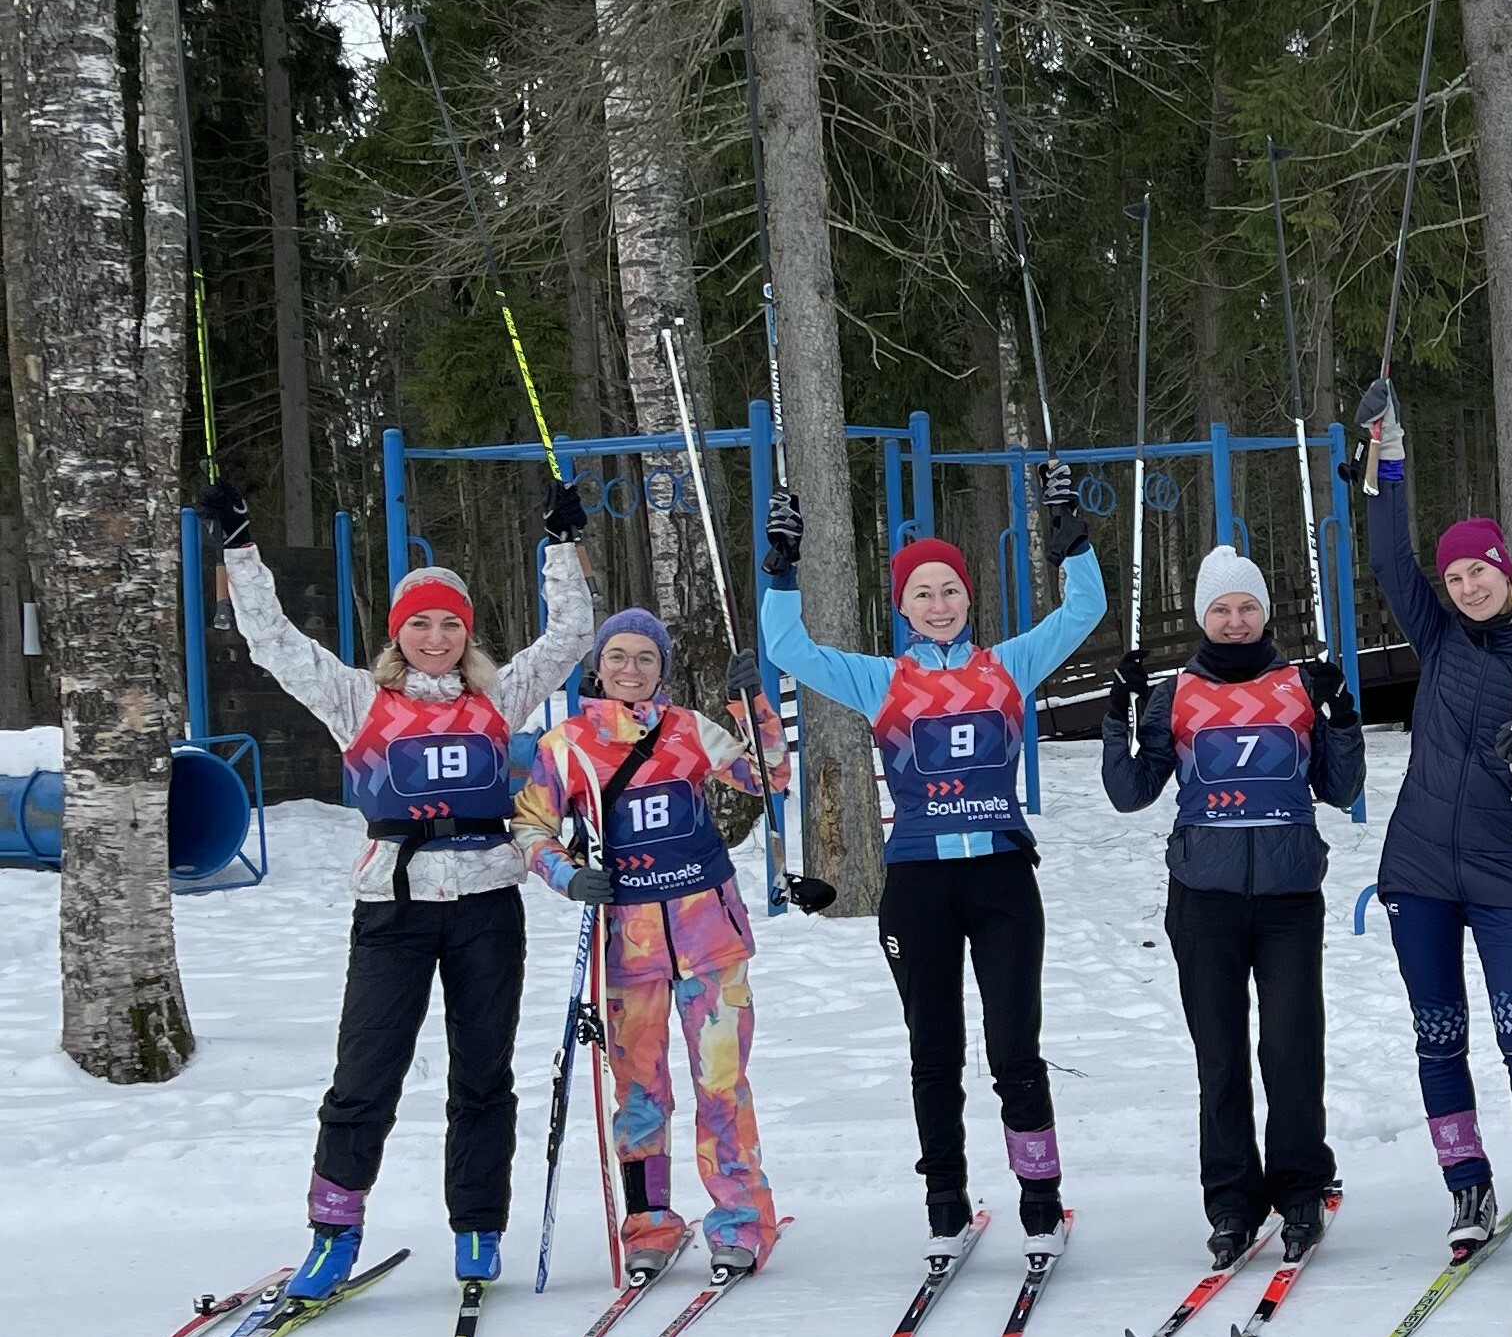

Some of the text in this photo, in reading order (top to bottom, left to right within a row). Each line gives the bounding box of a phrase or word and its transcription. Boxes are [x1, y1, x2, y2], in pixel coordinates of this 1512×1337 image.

[1133, 563, 1141, 602] LEKI
[951, 724, 975, 758] 9
[1236, 735, 1260, 767] 7
[423, 745, 468, 780] 19
[628, 794, 670, 832] 18
[926, 796, 1009, 817] Soulmate
[967, 812, 1012, 821] SPORT CLUB
[619, 863, 702, 888] Soulmate
[1400, 1286, 1439, 1331] FISCHER
